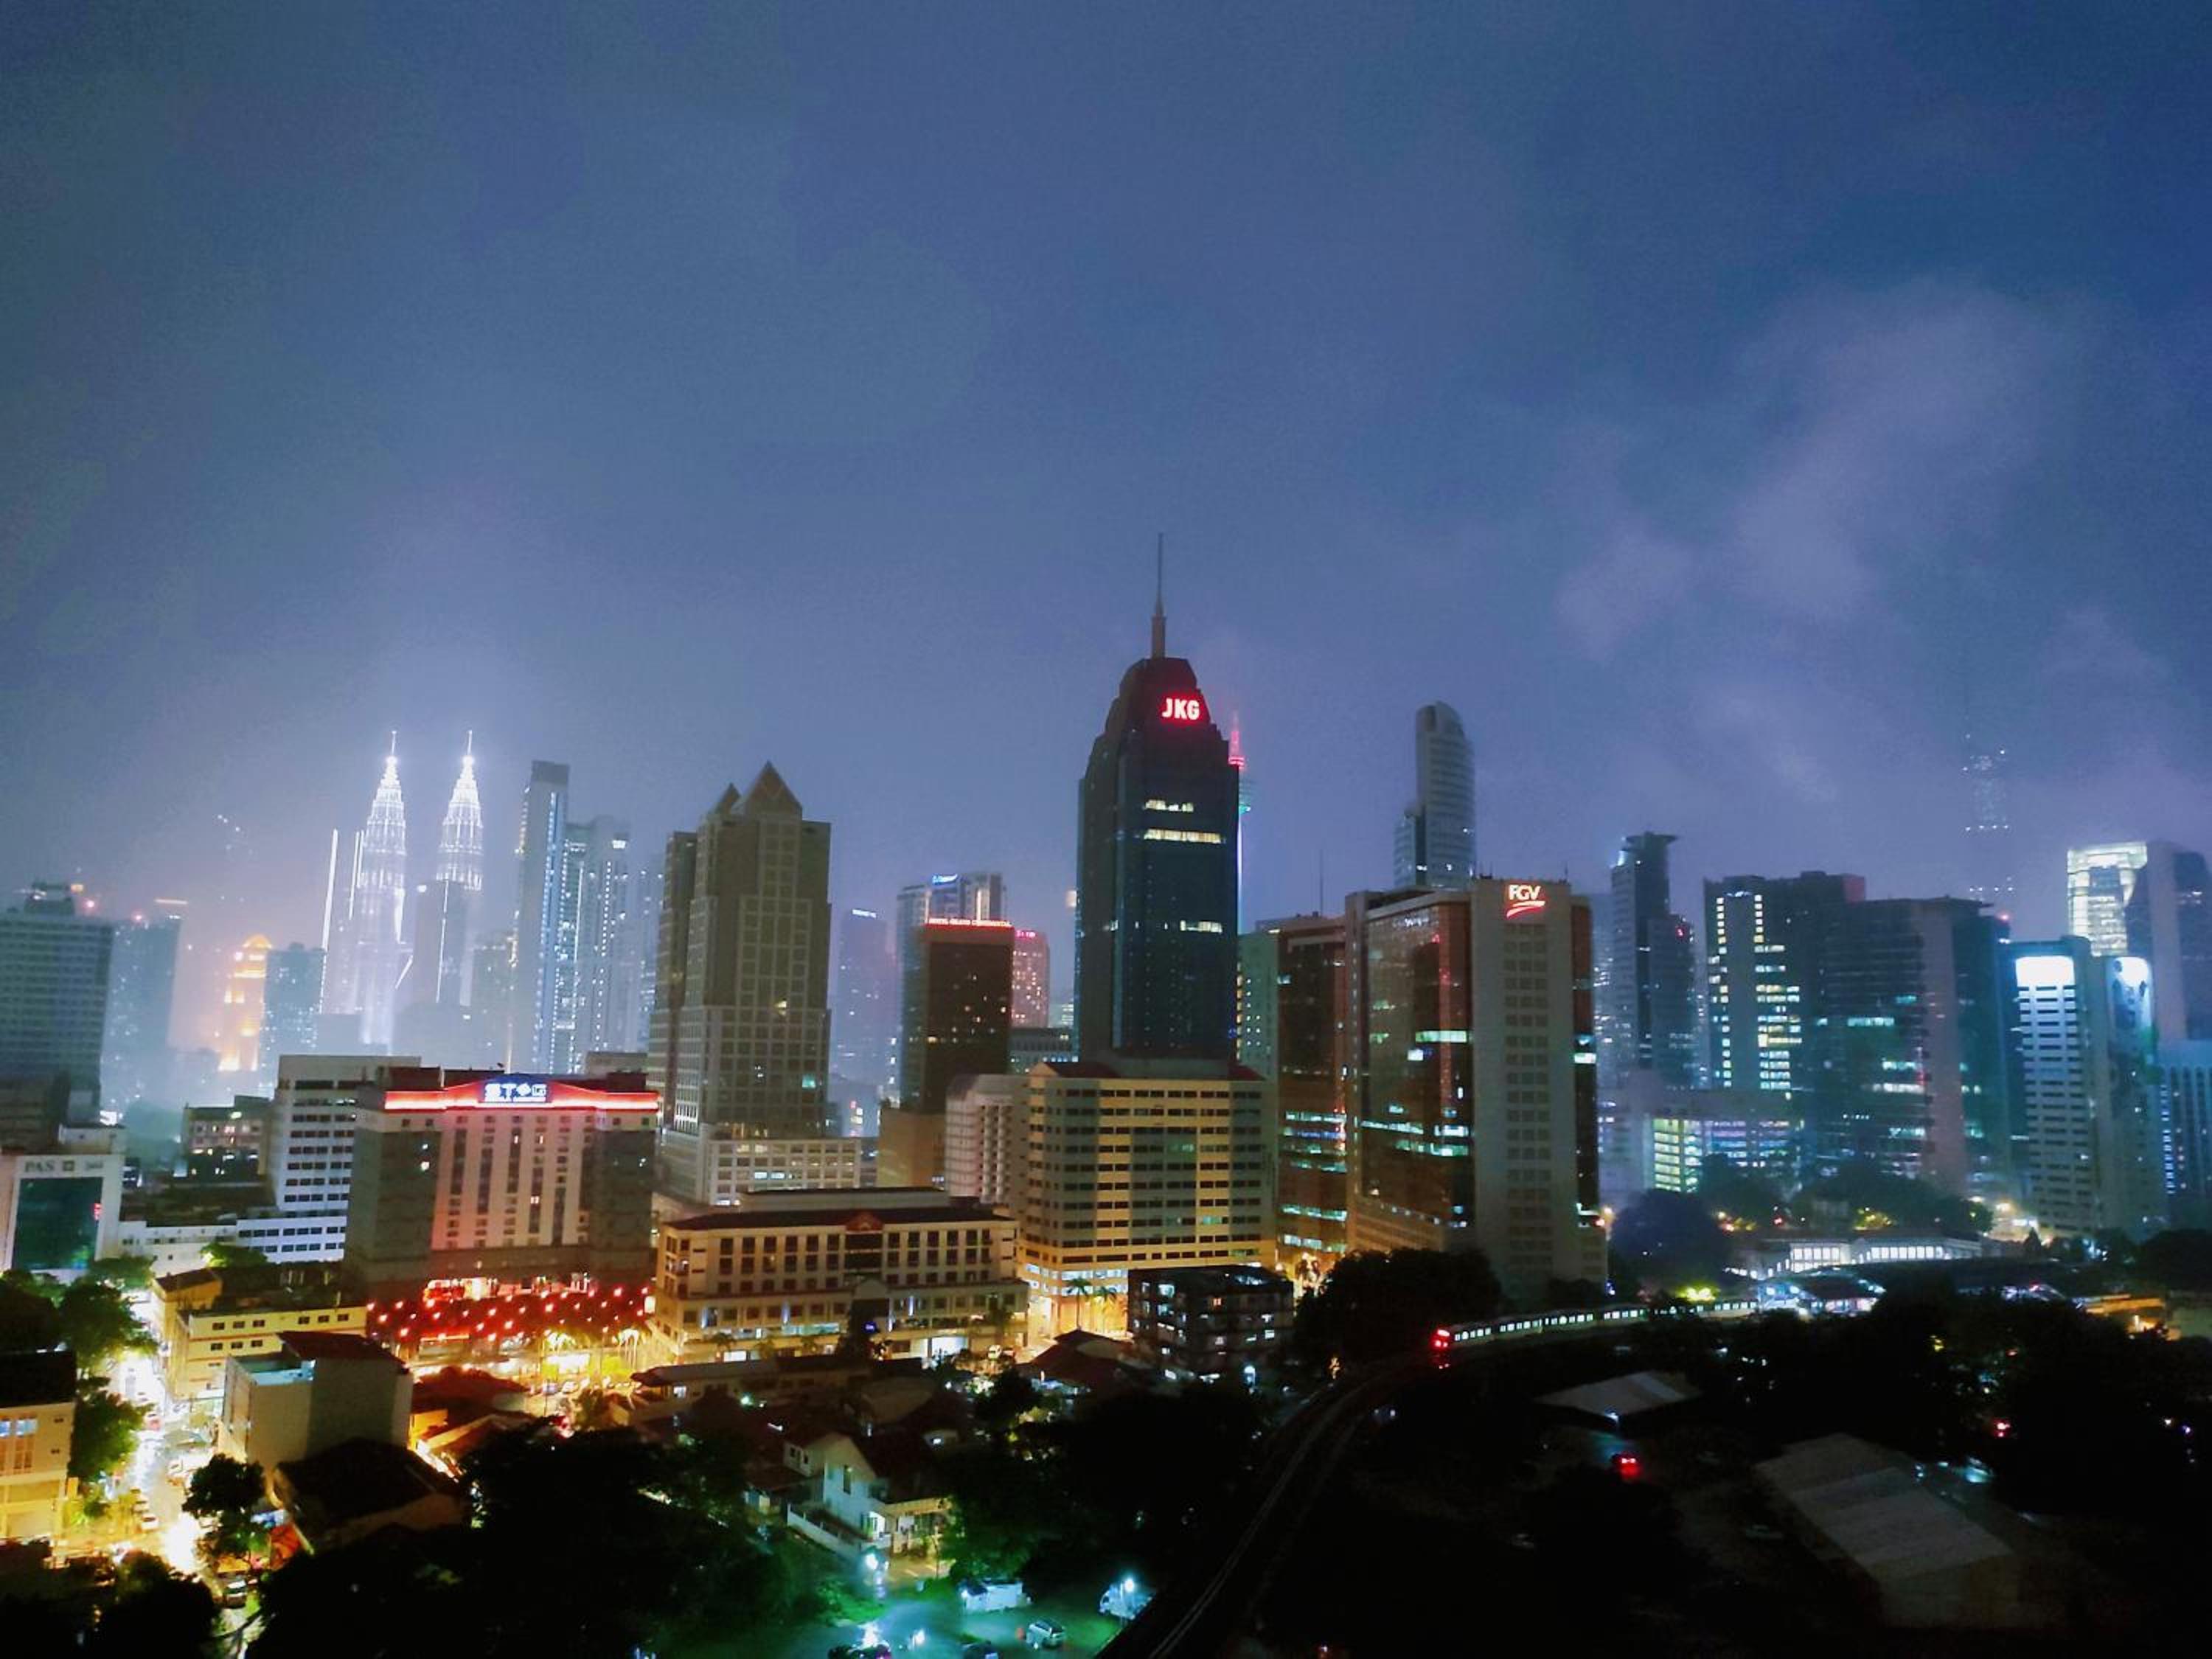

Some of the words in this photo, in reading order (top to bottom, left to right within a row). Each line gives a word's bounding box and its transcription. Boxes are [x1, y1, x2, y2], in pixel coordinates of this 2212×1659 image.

[1162, 698, 1200, 720] JKG
[1509, 884, 1541, 900] FGV
[24, 1160, 55, 1173] PAS
